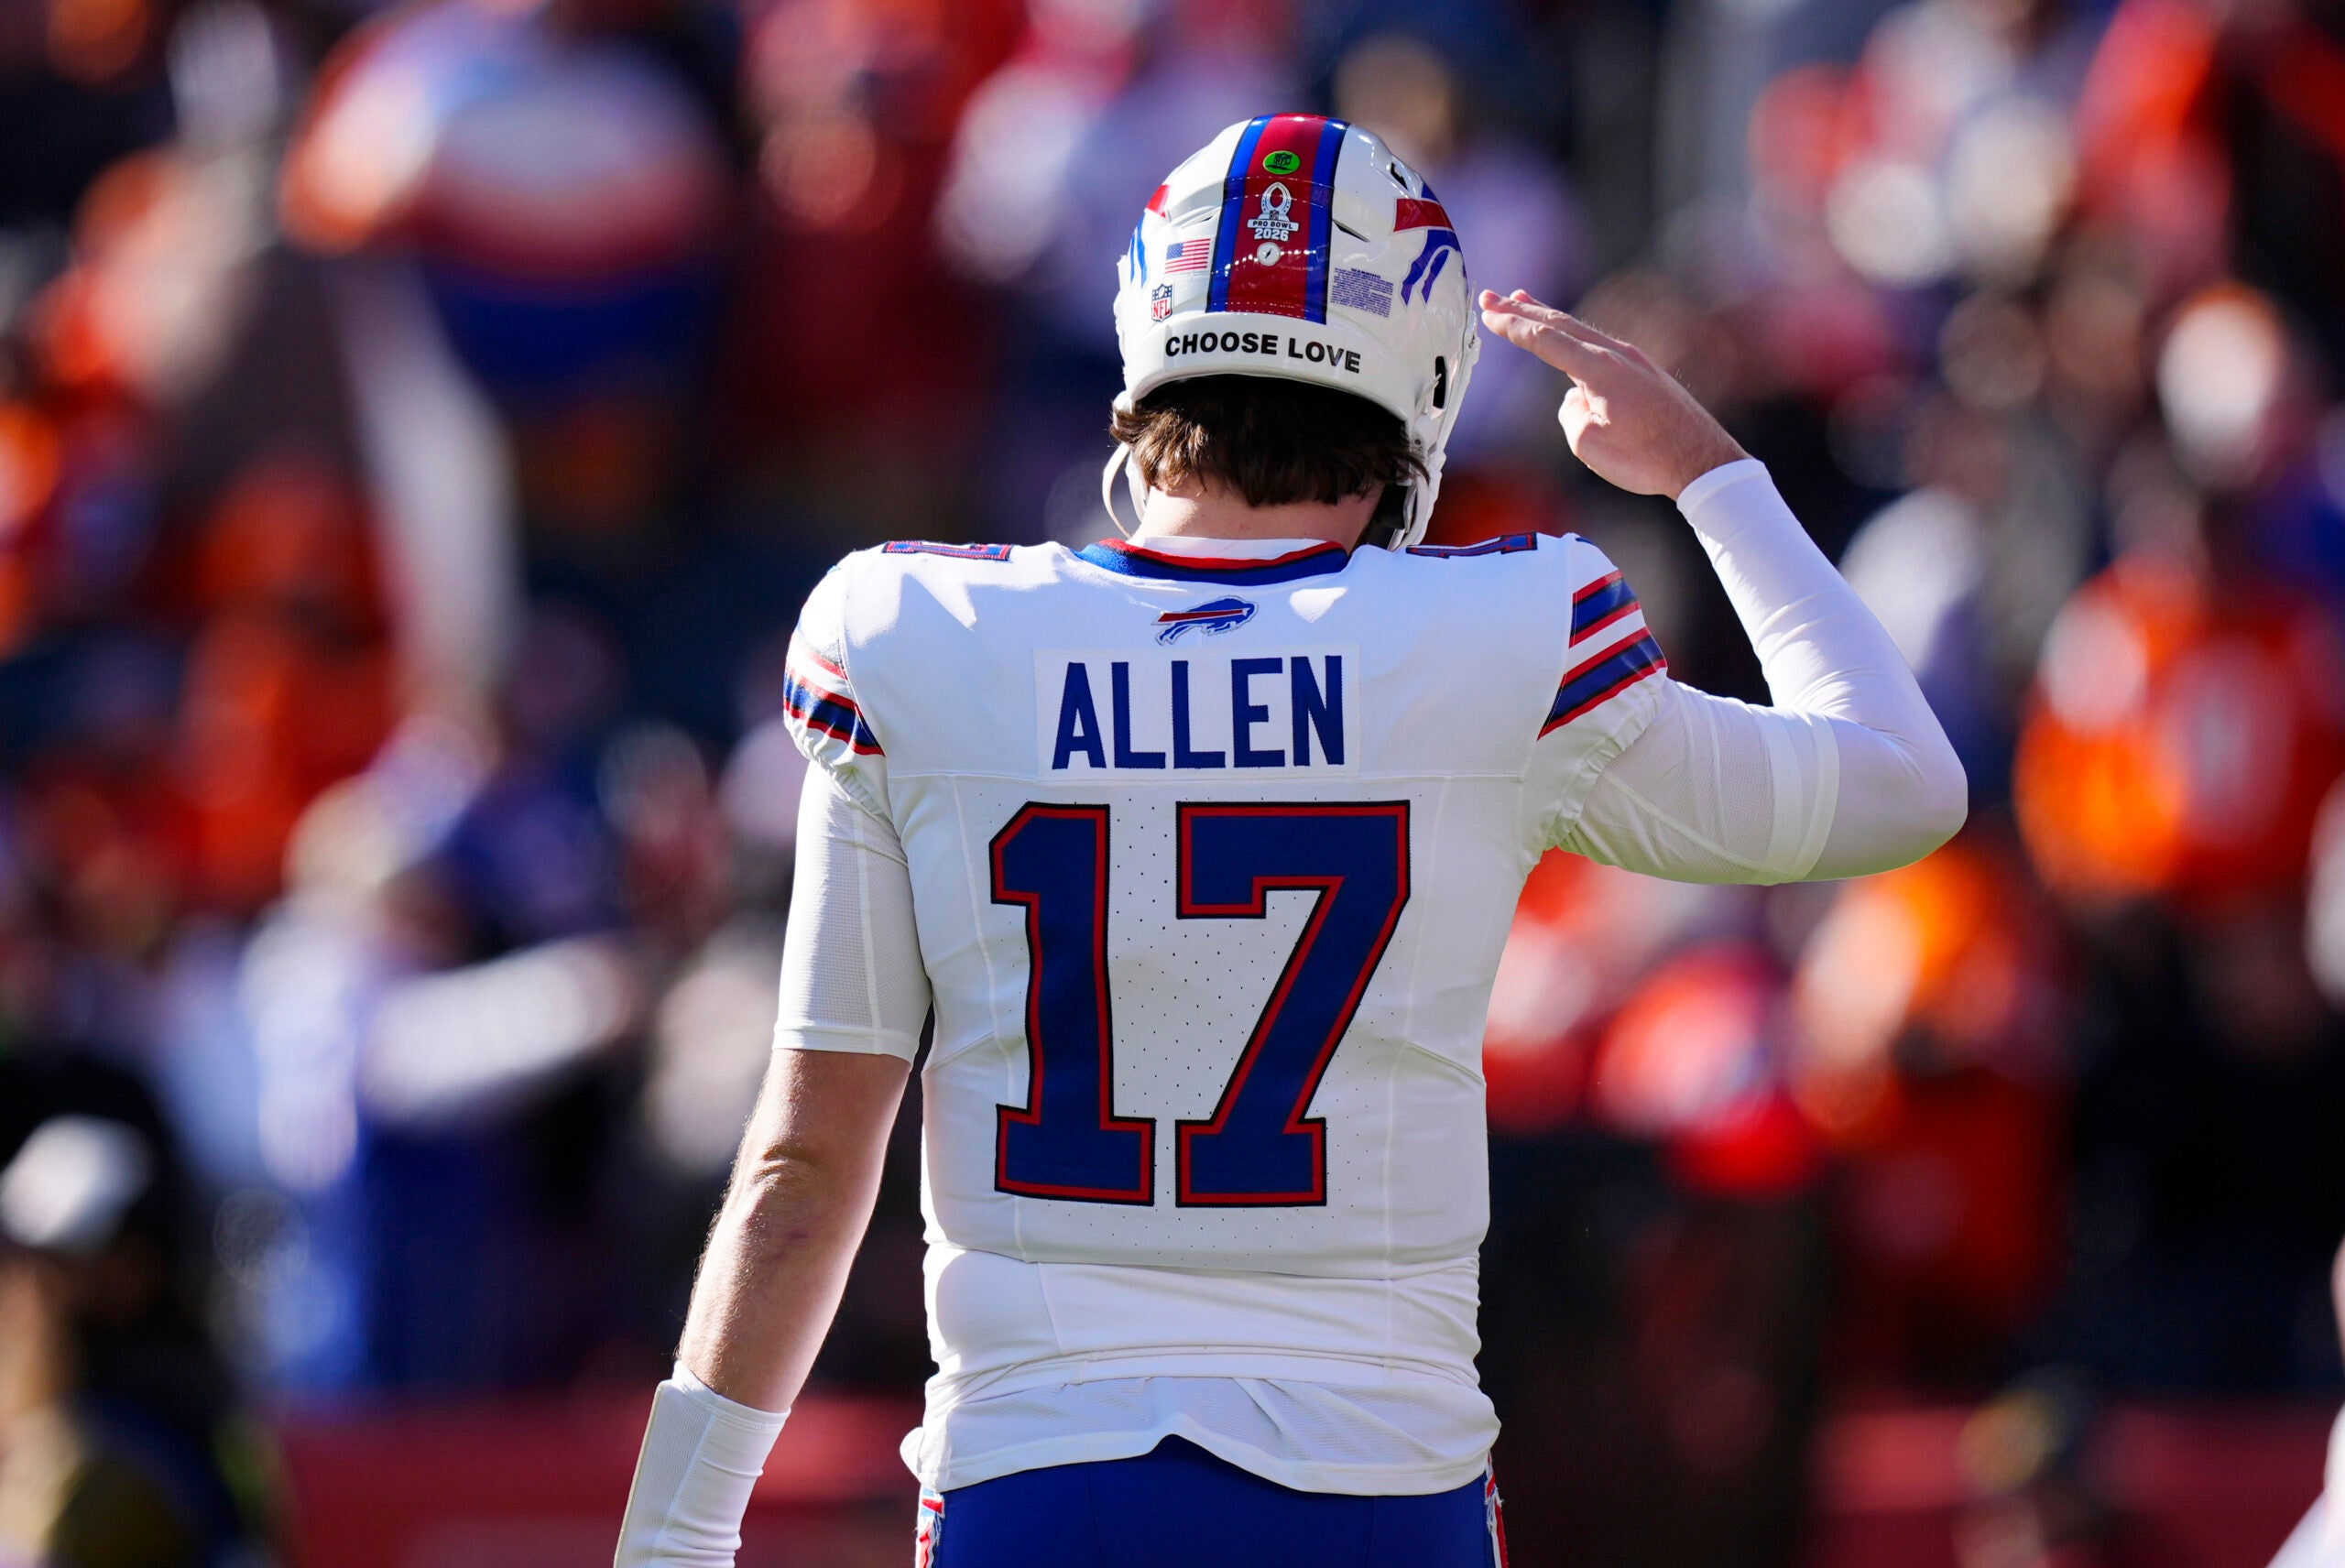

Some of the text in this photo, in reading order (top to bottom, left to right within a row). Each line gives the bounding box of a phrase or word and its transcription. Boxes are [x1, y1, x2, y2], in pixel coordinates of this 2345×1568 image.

[1254, 228, 1289, 241] 2026
[1153, 299, 1171, 319] NFL
[1165, 332, 1361, 374] CHOOSE LOVE
[1052, 656, 1345, 770] ALLEN
[989, 800, 1411, 1207] 17
